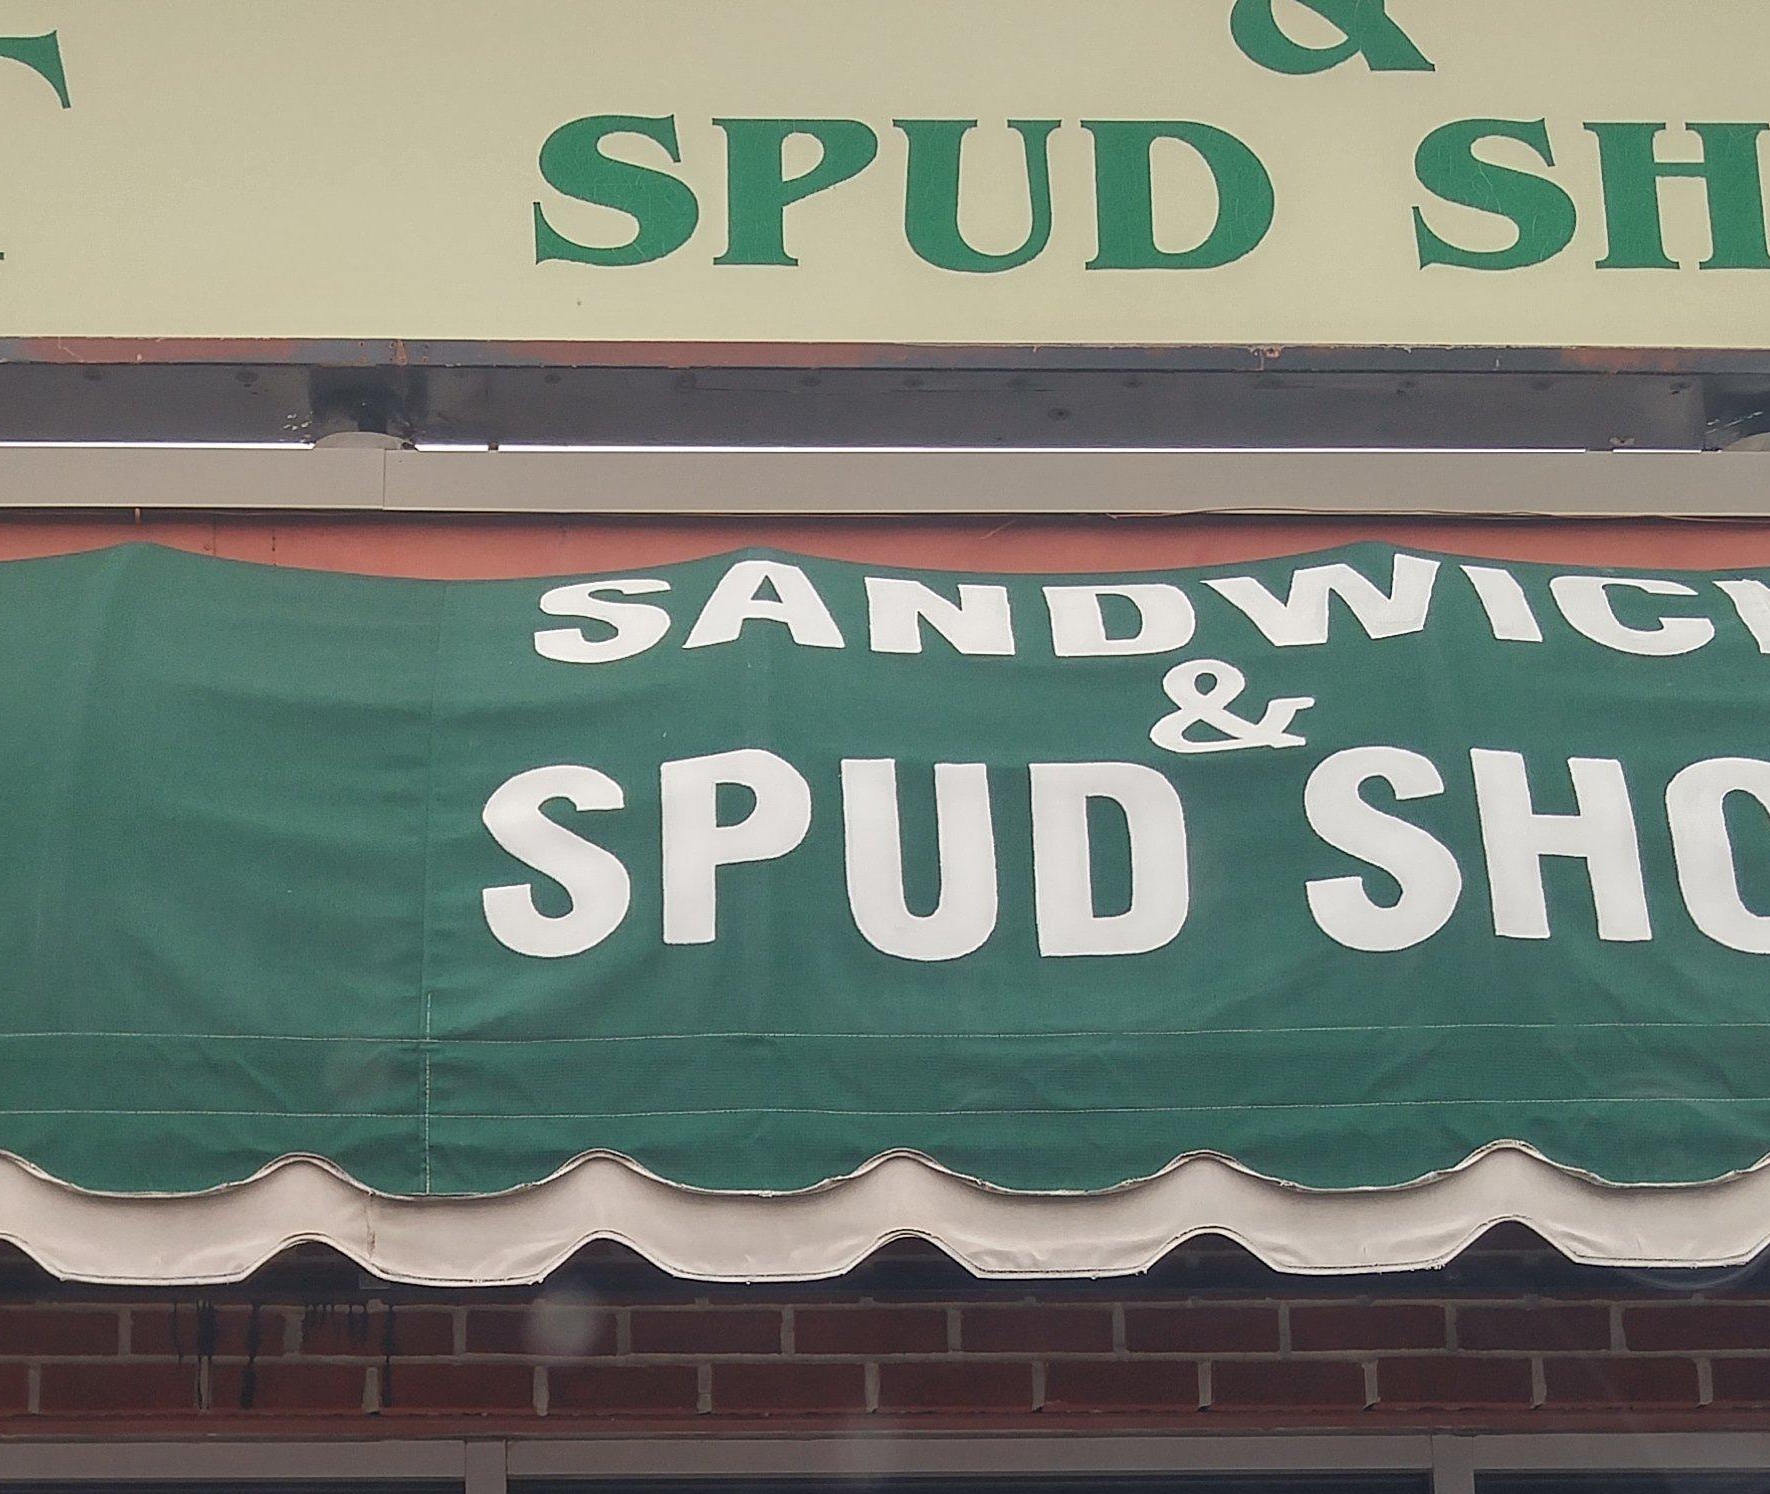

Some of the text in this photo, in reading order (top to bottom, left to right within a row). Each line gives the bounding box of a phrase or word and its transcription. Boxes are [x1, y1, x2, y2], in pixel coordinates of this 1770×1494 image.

[533, 113, 1277, 273] SPUD
[1148, 658, 1317, 753] &
[481, 748, 1191, 961] SPUD
